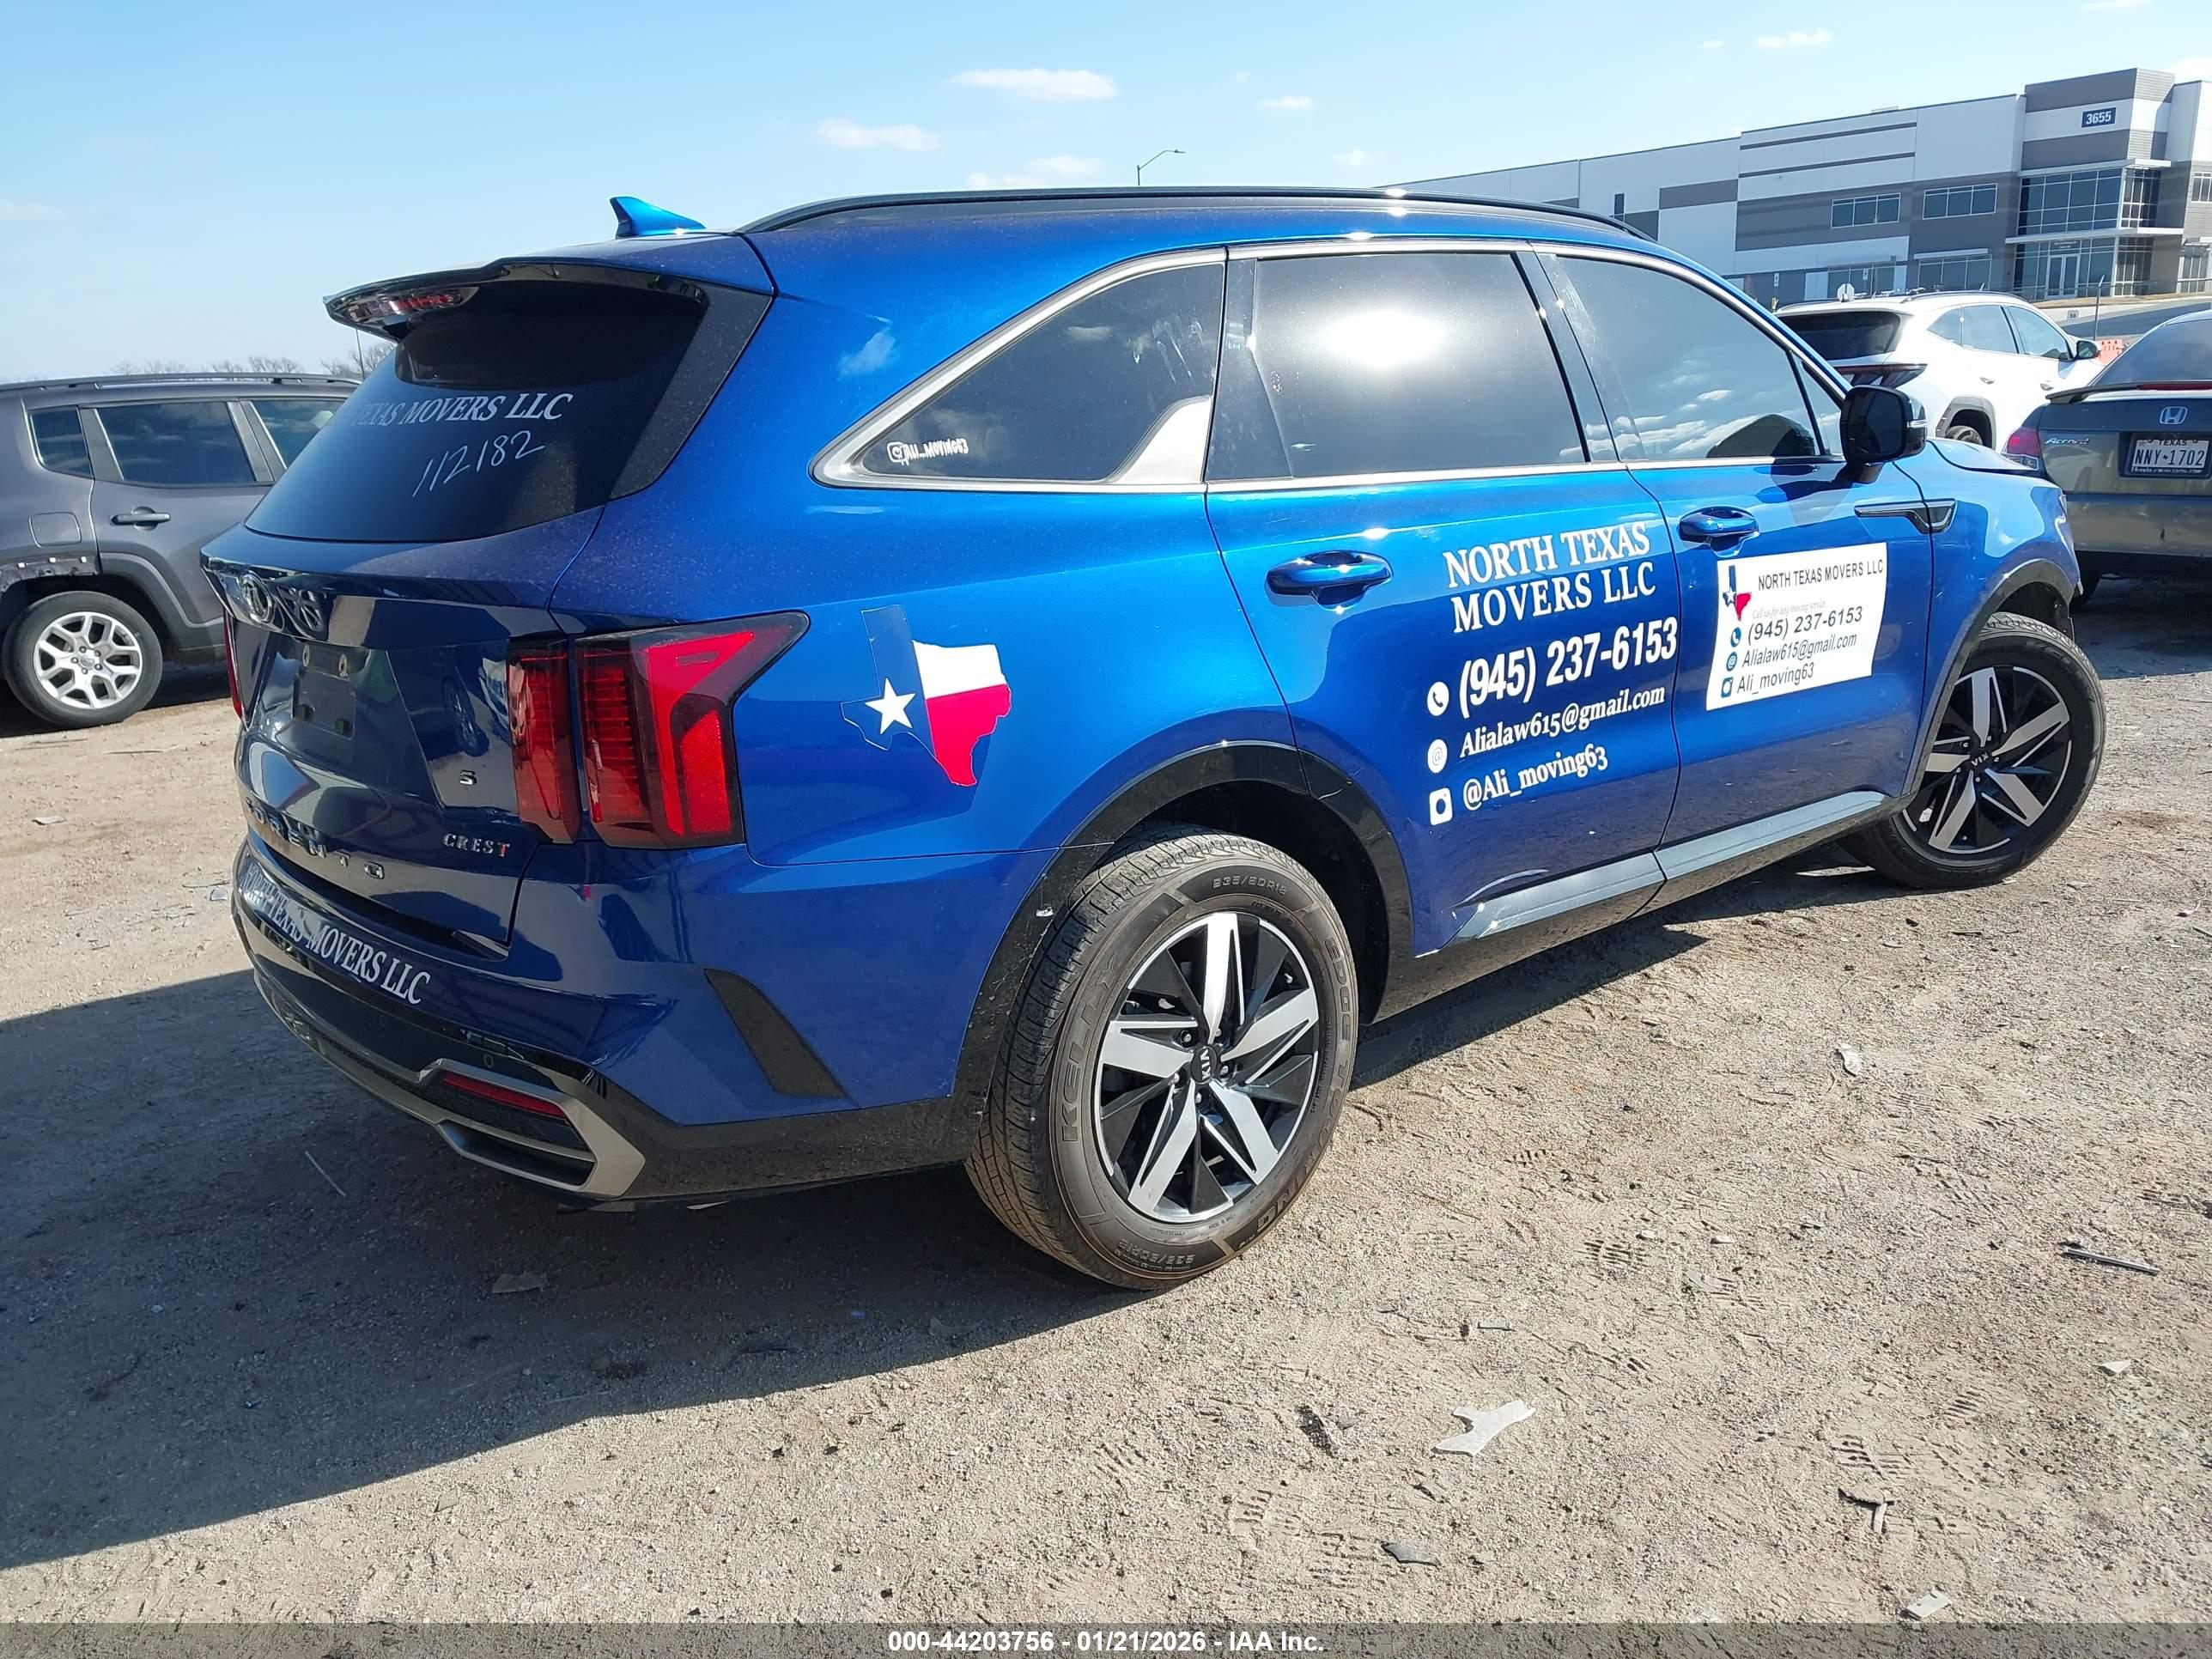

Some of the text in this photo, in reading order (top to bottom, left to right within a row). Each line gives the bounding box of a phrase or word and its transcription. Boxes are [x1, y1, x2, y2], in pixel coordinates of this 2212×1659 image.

[2086, 111, 2112, 125] 3655
[398, 395, 506, 425] MOVERS
[505, 392, 574, 420] LLC
[1443, 521, 1650, 588] NORTH TEXAS
[1758, 558, 1884, 591] NORTH TEXAS MOVERS LLC
[1451, 562, 1656, 633] MOVERS LLC
[1748, 605, 1863, 645] (945) 237-6153
[1460, 617, 1678, 719] (945) 237-6153
[1742, 633, 1857, 667] Alialaw615@gmail.com
[1736, 662, 1814, 694] Ali_moving63
[1460, 687, 1665, 758] Alialaw615@gmail.com
[1463, 744, 1608, 811] @Ali_moving63
[443, 833, 511, 858] CREST
[305, 922, 386, 983] MOVERS
[380, 957, 431, 1005] LLC
[1062, 951, 1117, 1141] KELLY
[1200, 1048, 1212, 1080] KIA
